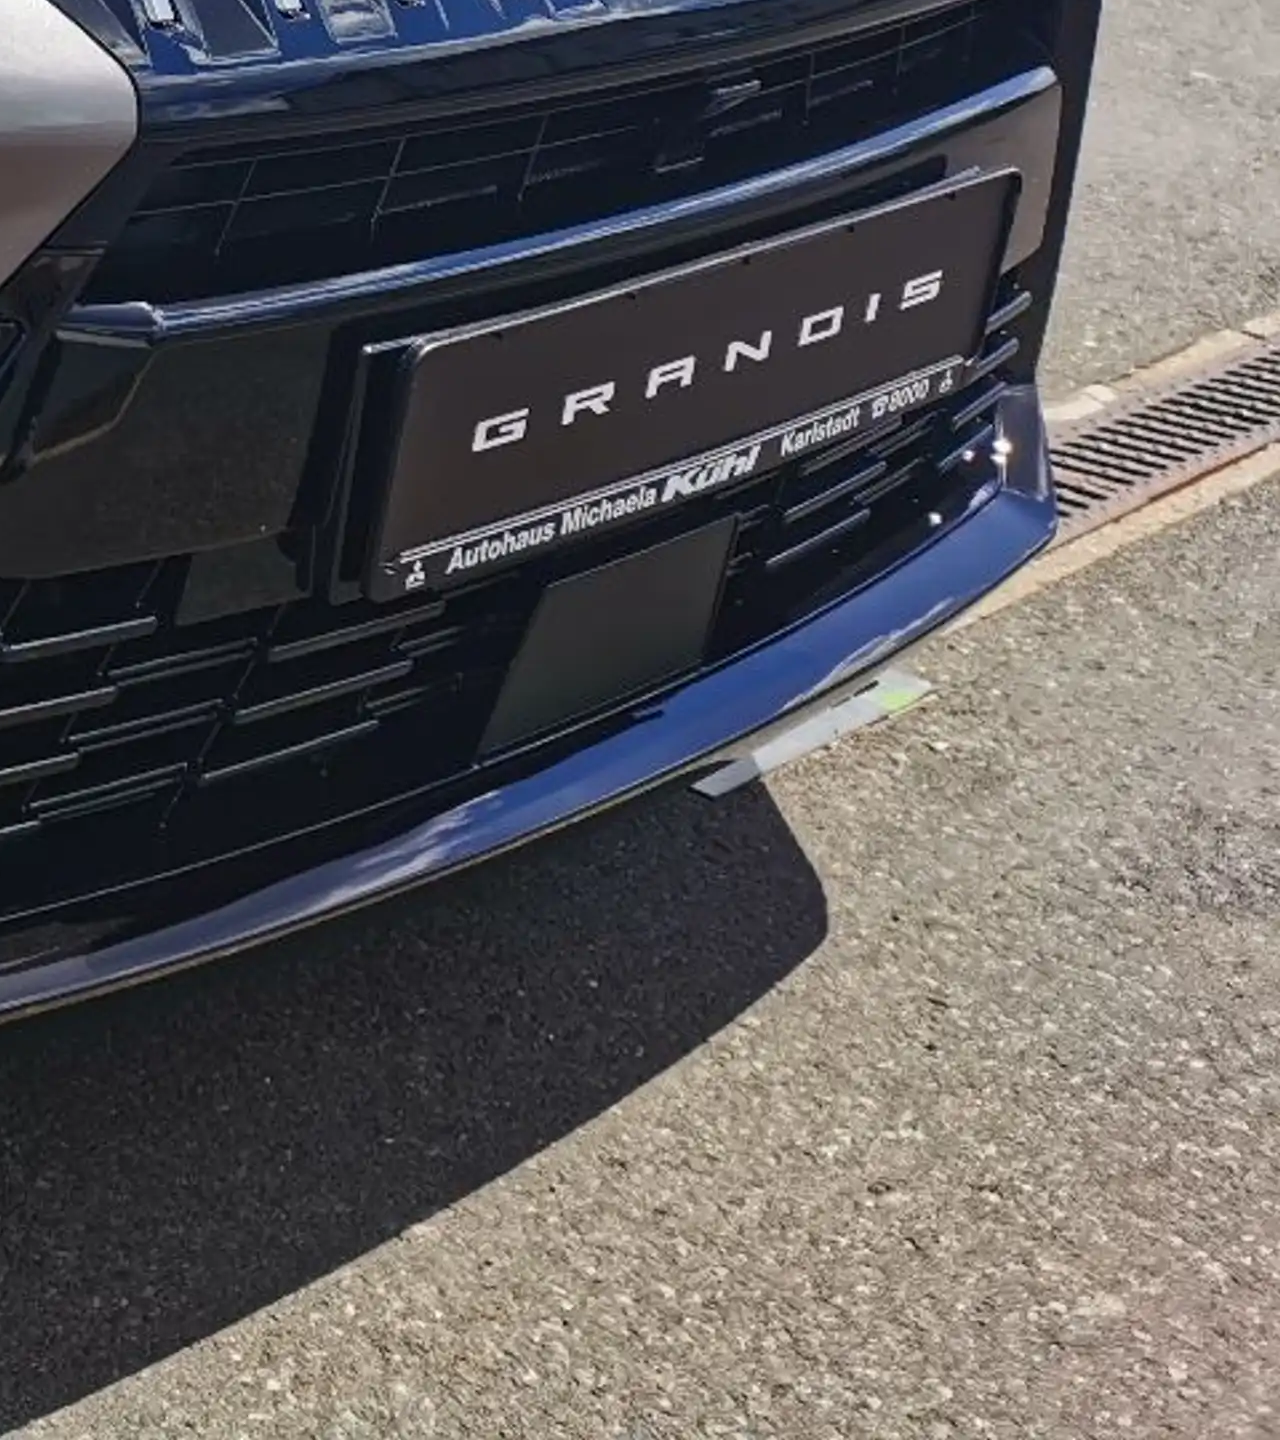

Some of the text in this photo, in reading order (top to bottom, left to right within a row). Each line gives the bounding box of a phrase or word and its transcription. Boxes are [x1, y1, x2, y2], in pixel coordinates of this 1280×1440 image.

[472, 270, 943, 452] GRANDIS
[444, 521, 556, 575] Autohaus
[560, 486, 657, 536] Michaela
[661, 446, 762, 503] Kühl
[781, 407, 860, 457] Karlstadt
